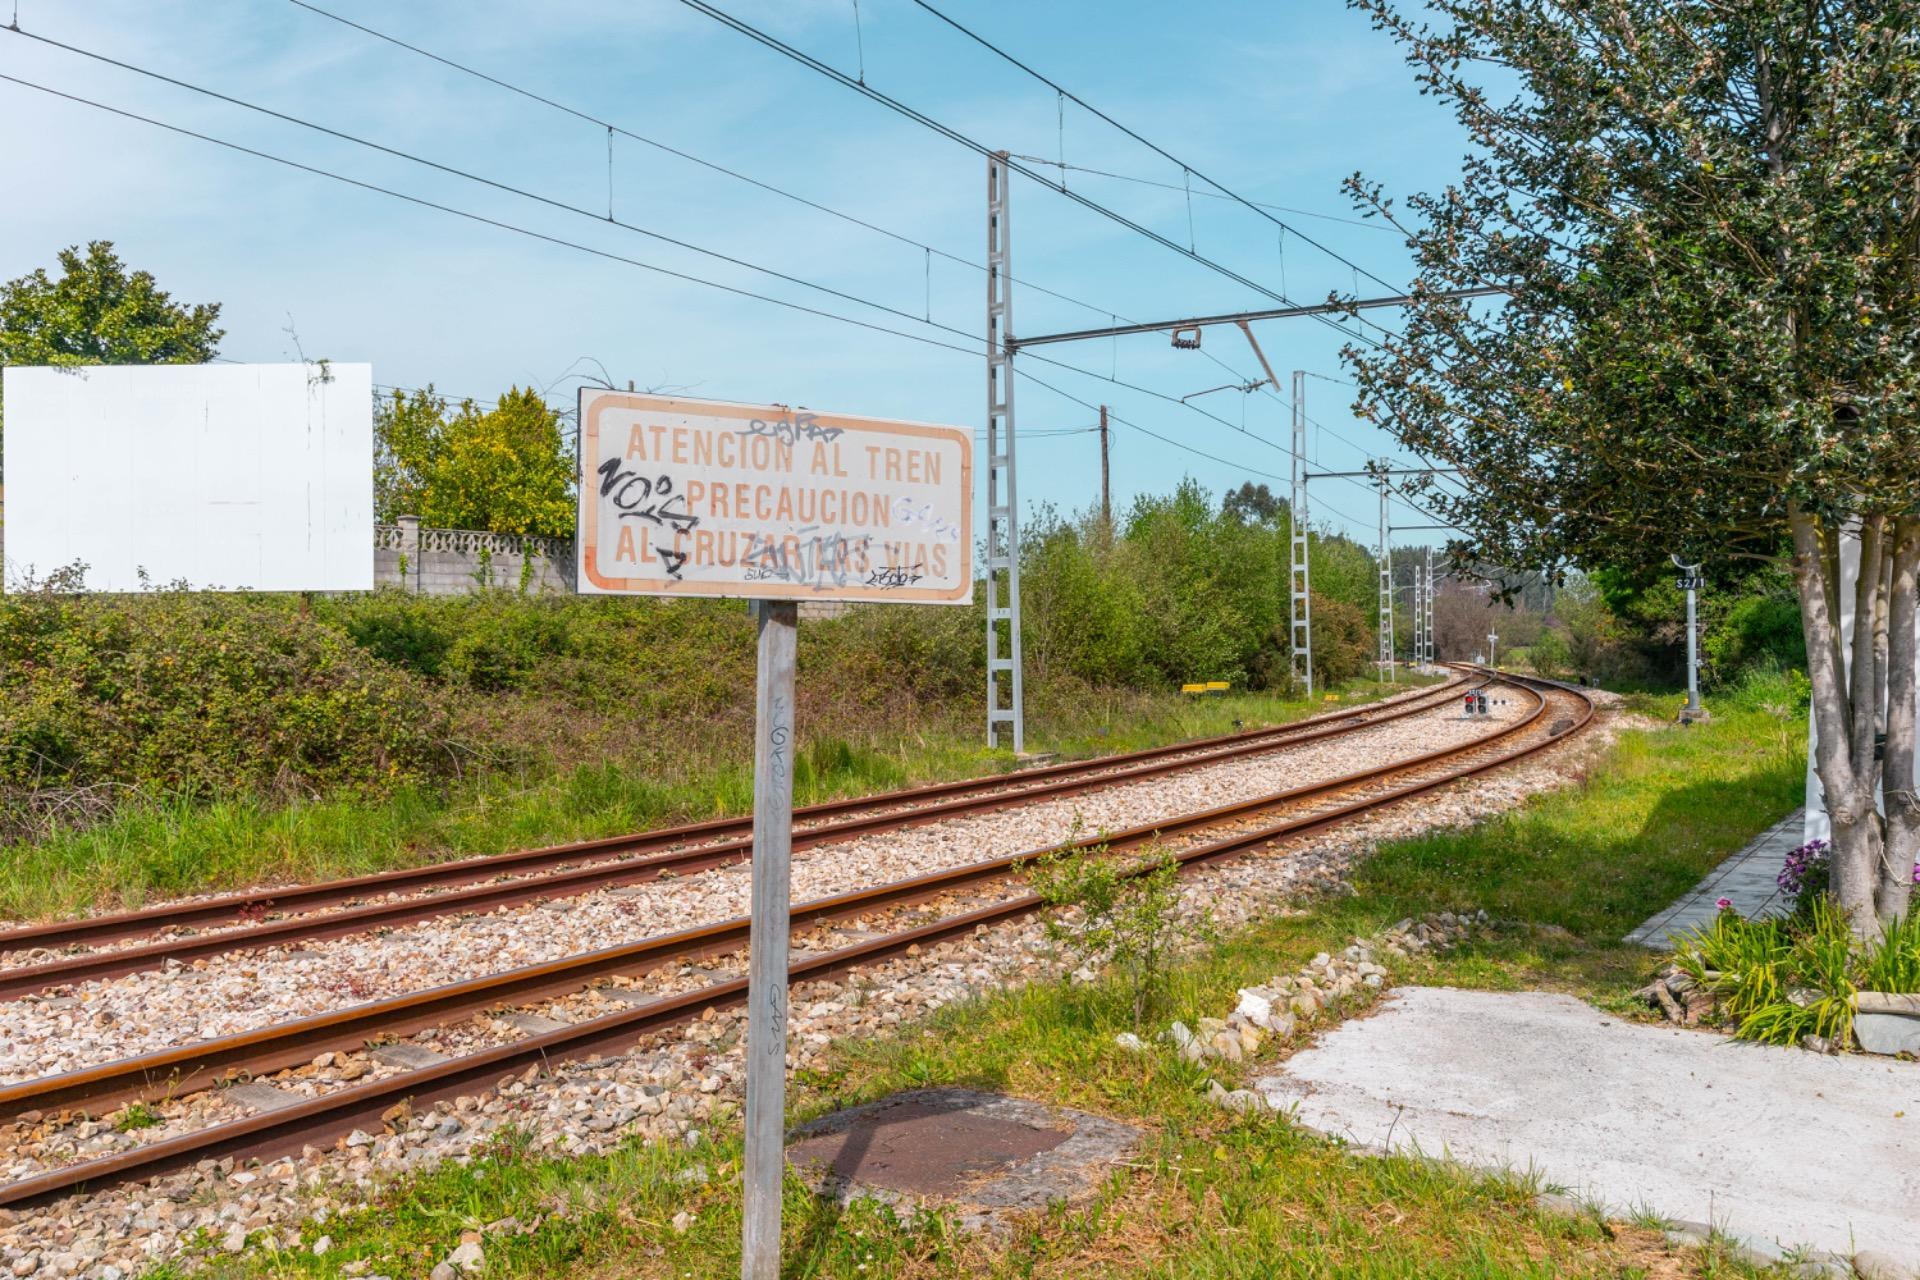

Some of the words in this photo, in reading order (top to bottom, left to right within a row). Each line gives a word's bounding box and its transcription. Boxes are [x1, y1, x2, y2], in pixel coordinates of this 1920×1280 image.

[625, 423, 793, 473] ATENCION
[811, 441, 848, 478] AL
[865, 445, 942, 486] TREN
[686, 480, 890, 528] PRECAUCION
[615, 525, 658, 563] AL
[673, 528, 800, 571] CRUZAR
[815, 534, 870, 574] LAS
[884, 541, 947, 578] VIAS
[1676, 577, 1704, 588] S2/1
